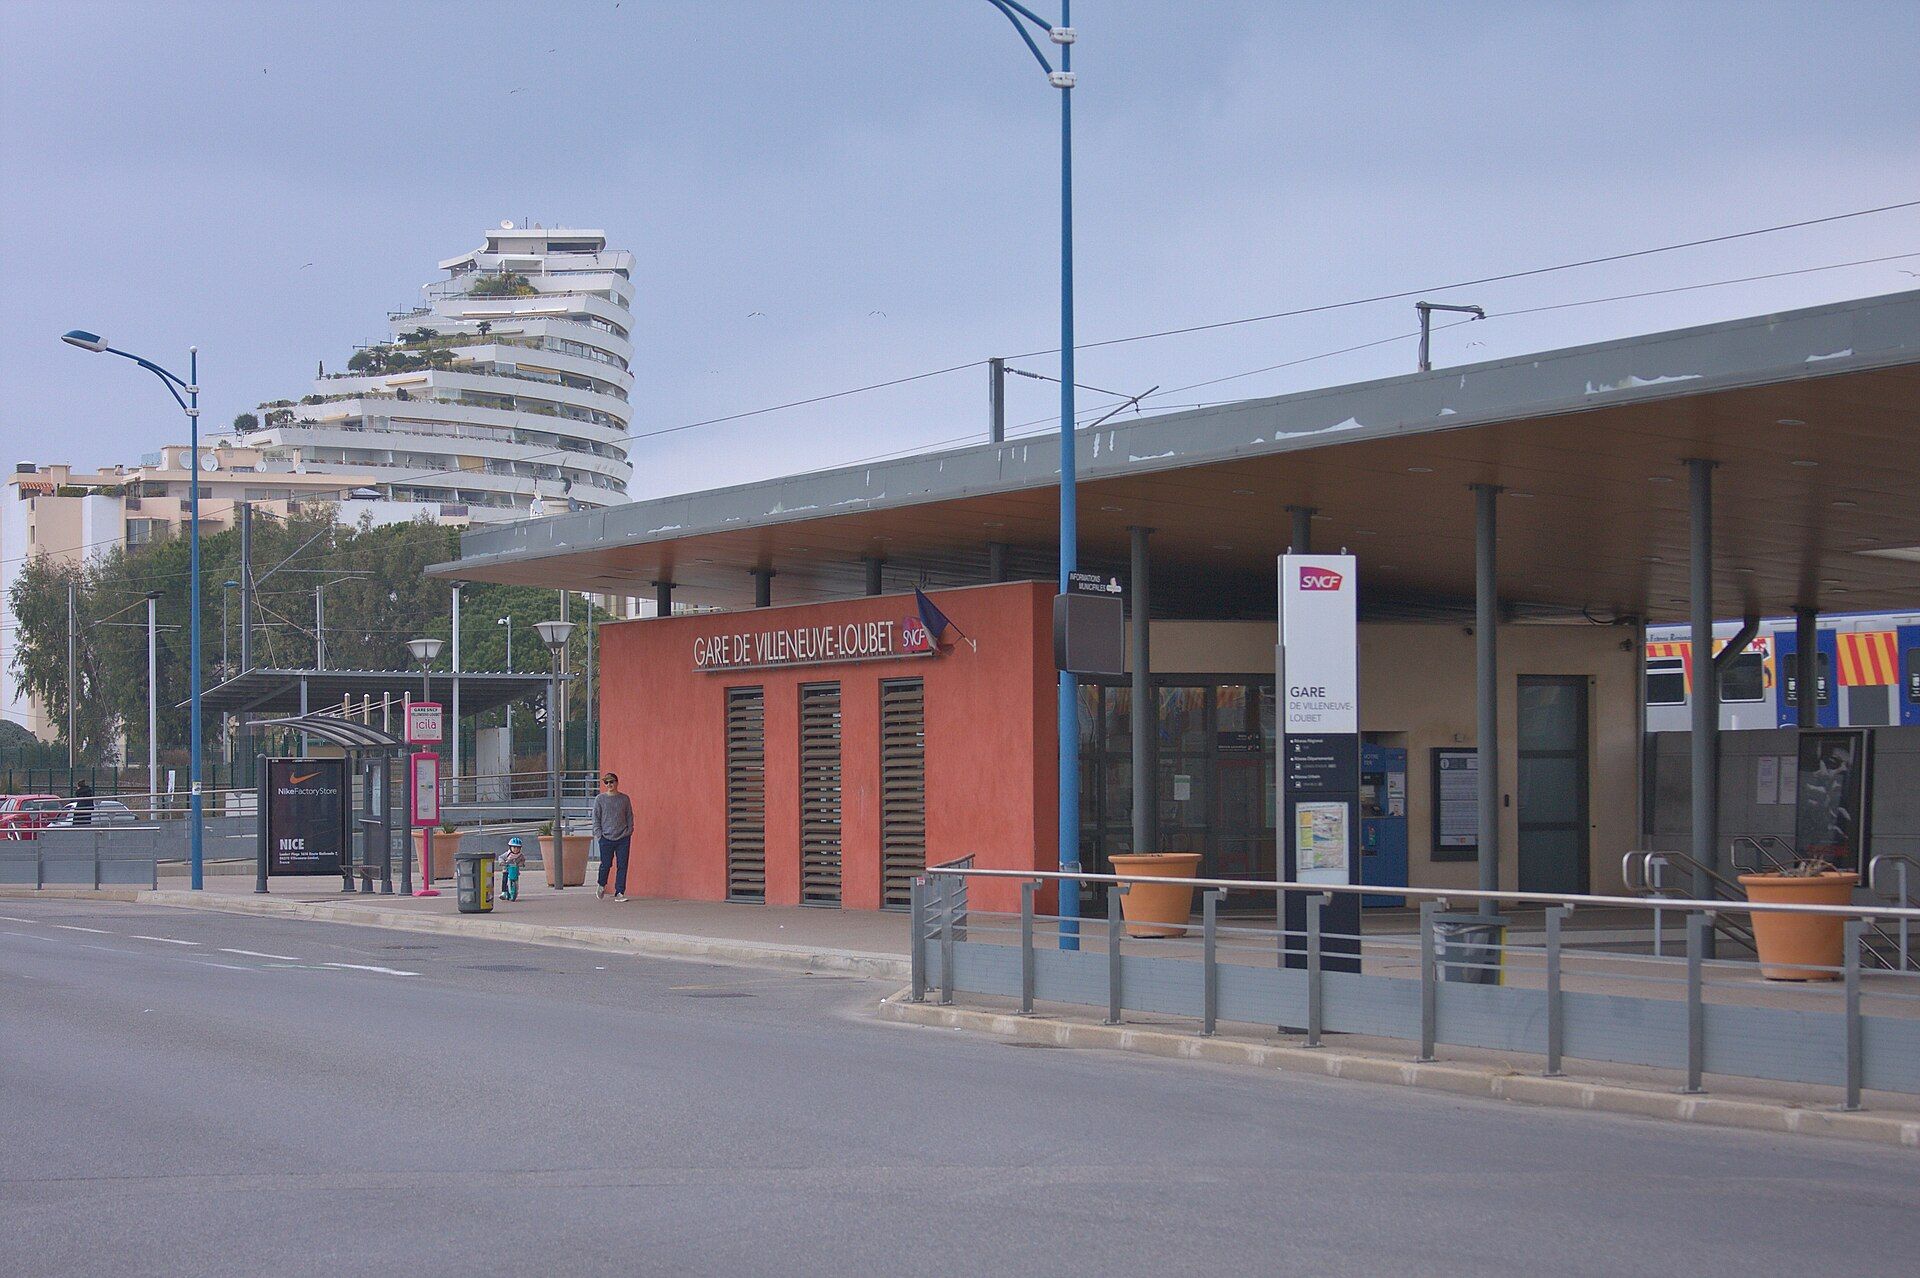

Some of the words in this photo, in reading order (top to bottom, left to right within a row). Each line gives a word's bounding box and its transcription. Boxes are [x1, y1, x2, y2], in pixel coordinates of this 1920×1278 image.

[1069, 573, 1101, 583] INFORMATIONS
[1301, 575, 1341, 589] SNCF
[1079, 583, 1106, 592] MUNICIPALES
[693, 635, 729, 666] GARE
[734, 634, 751, 663] DE
[755, 620, 894, 662] VILLENEUVE-LOUBET
[902, 628, 926, 648] SNCF
[1290, 686, 1326, 698] GARE
[1289, 701, 1302, 710] DE
[1303, 701, 1354, 711] VILLENEUVE-
[1289, 713, 1322, 723] LOUBET
[278, 787, 338, 796] NikeFactoryStore
[279, 839, 305, 850] NICE
